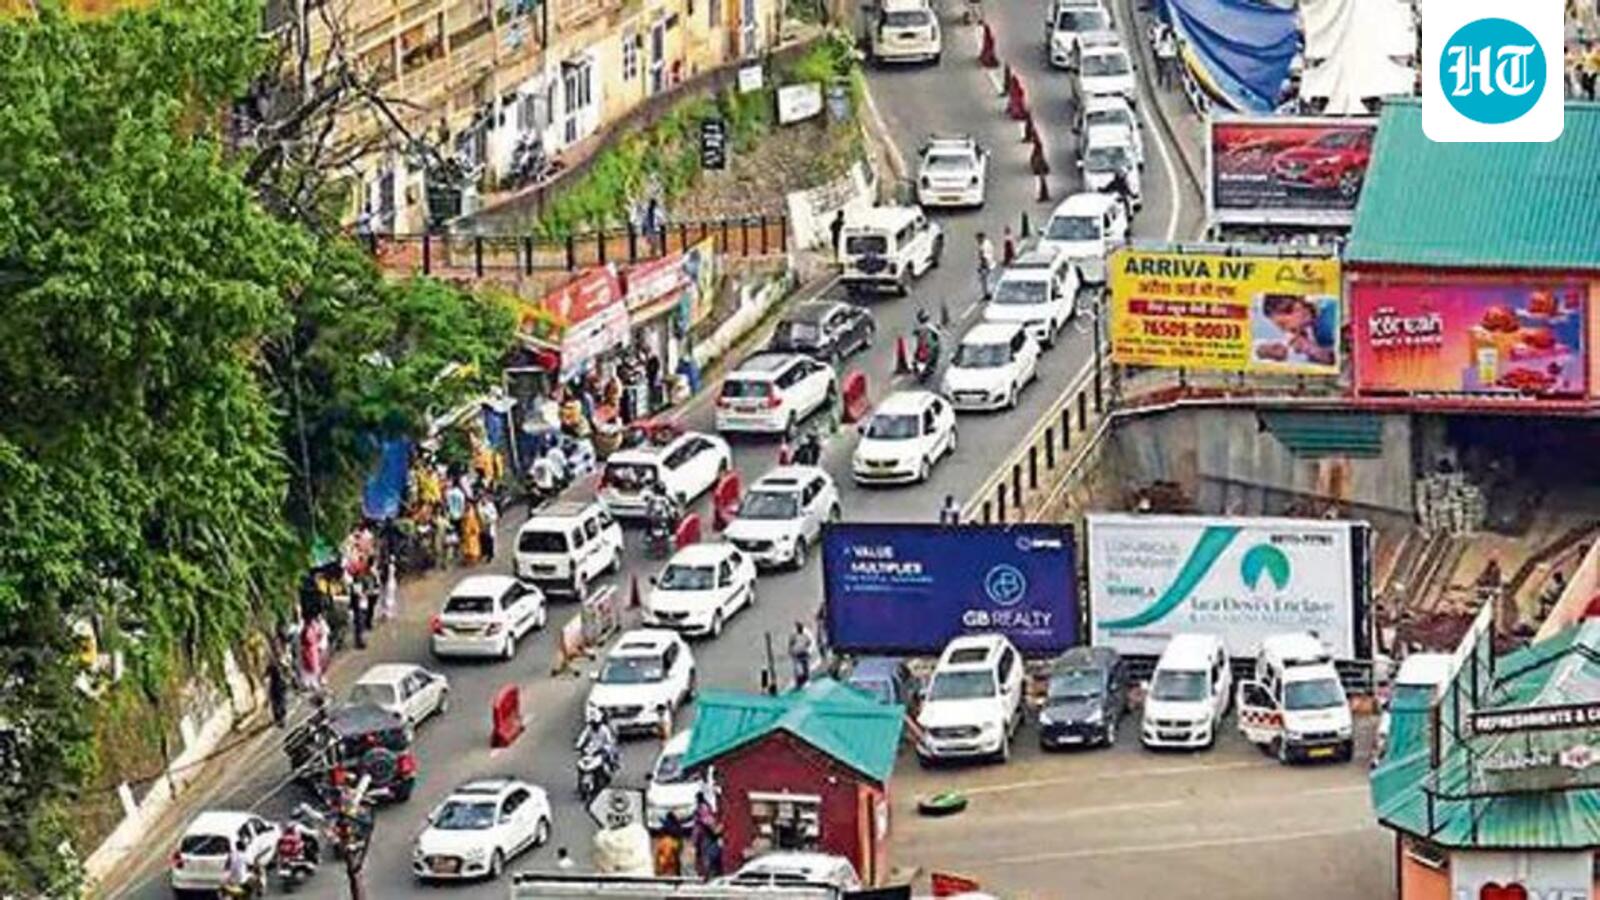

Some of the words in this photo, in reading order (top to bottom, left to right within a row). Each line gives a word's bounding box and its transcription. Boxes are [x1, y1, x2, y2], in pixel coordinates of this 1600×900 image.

[1124, 257, 1210, 278] ARRIVA
[1219, 261, 1256, 280] IVF
[962, 609, 991, 628] GB
[992, 609, 1053, 630] REALTY
[1475, 709, 1571, 731] REFRESHMENTS
